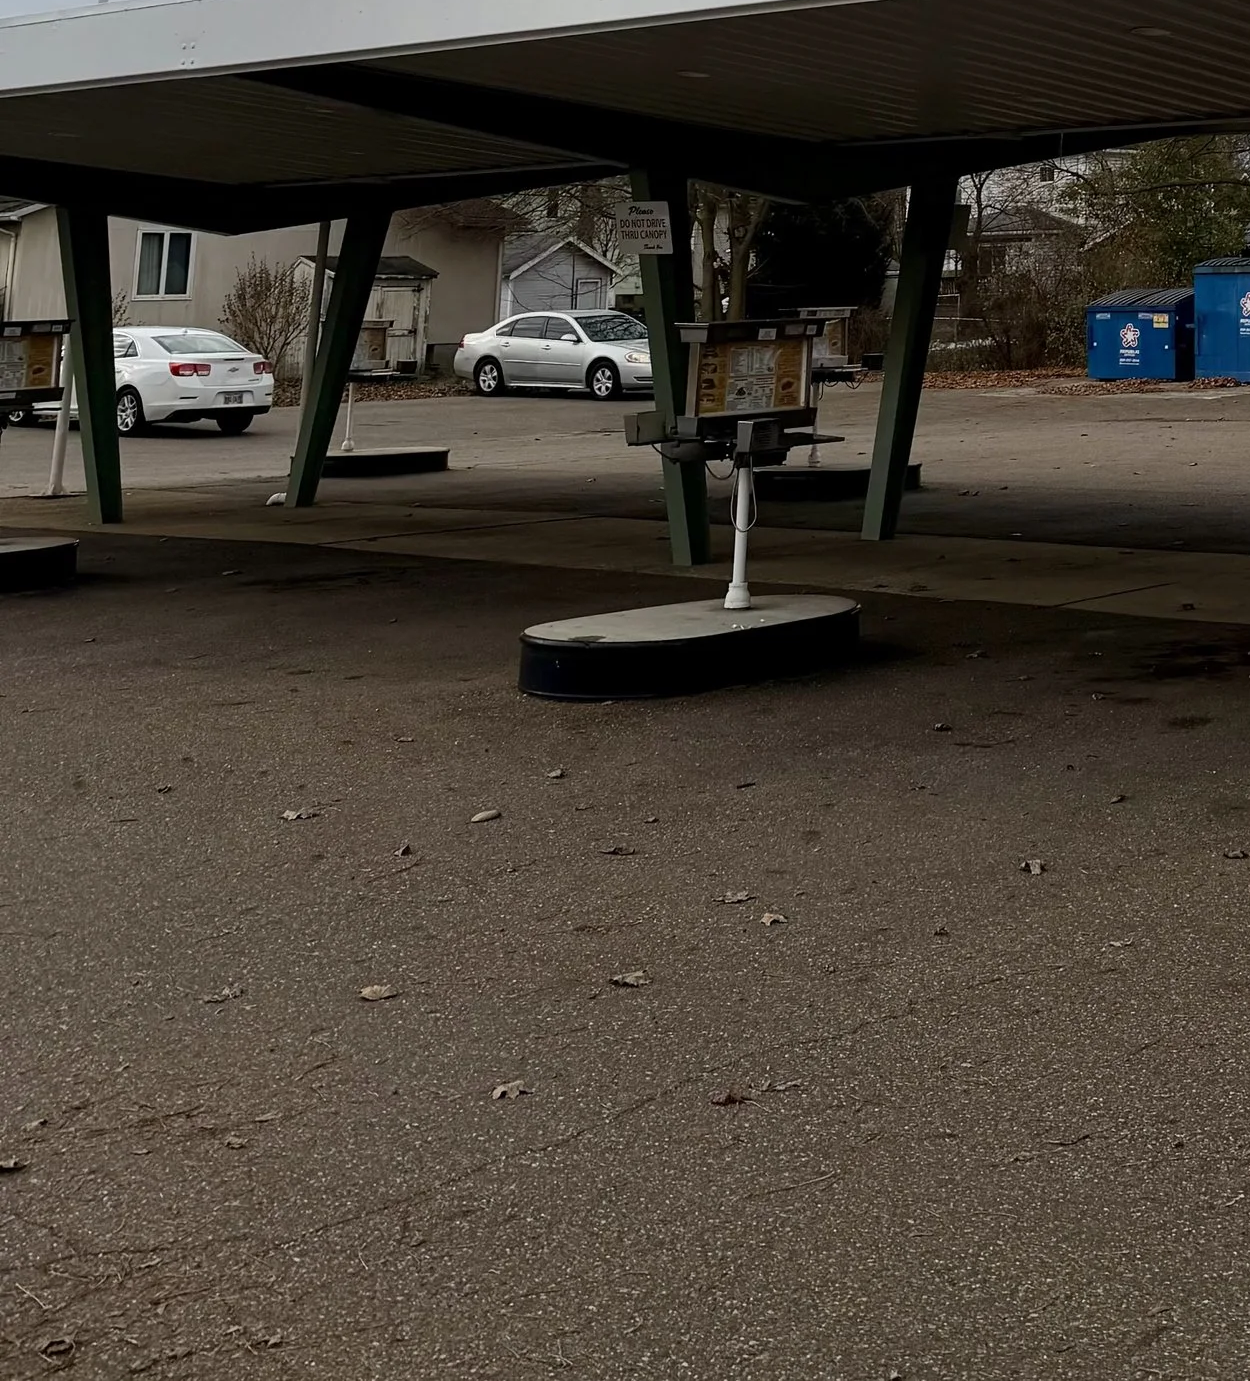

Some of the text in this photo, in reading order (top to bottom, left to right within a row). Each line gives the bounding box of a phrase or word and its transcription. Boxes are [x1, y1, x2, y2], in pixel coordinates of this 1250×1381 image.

[620, 219, 666, 228] DO NOT DRIVE
[620, 230, 639, 239] THRU
